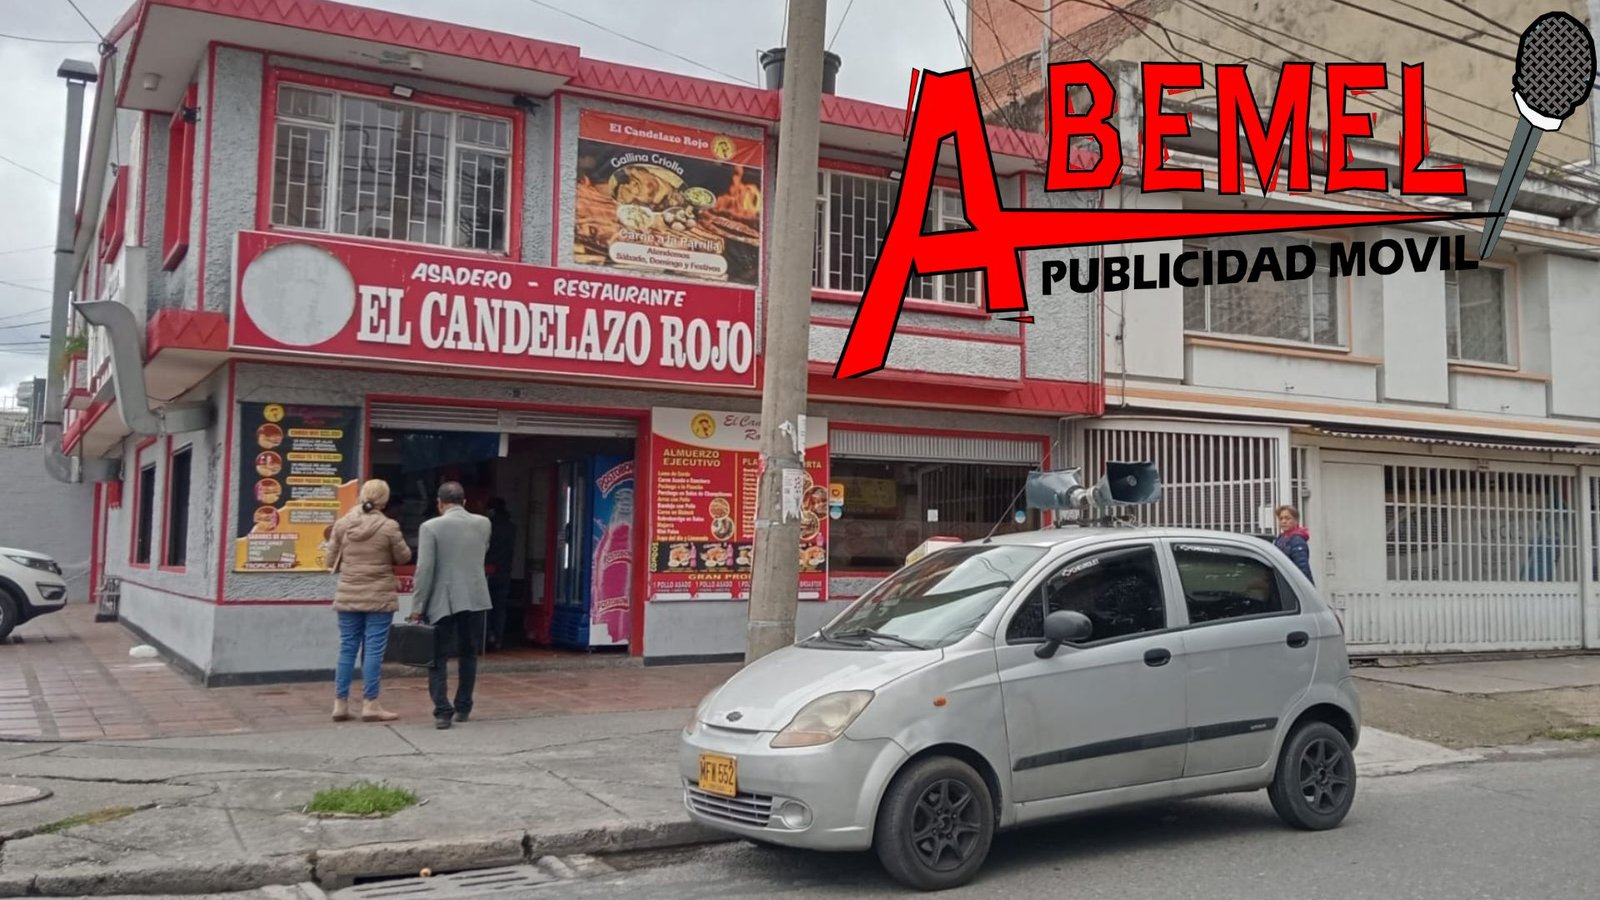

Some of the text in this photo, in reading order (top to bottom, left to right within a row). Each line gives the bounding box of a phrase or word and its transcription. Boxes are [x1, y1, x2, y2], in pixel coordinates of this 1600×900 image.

[609, 123, 709, 150] El Candelazo Rojo
[610, 153, 684, 176] Gallina Criolla
[619, 228, 654, 241] Carne
[679, 236, 721, 252] Parrilla
[647, 247, 690, 259] Atendemos
[649, 257, 684, 269] Domingo
[690, 261, 721, 273] Festivos
[411, 262, 512, 290] ASADERO
[553, 278, 687, 308] RESTAURANTE
[357, 285, 752, 374] EL CANDELAZO ROJO
[723, 414, 762, 428] El Can
[744, 429, 761, 440] Ro
[663, 448, 720, 459] ALMUERZO
[663, 457, 721, 468] EJECUTIVO
[742, 458, 758, 466] PLA
[718, 760, 734, 786] 552
